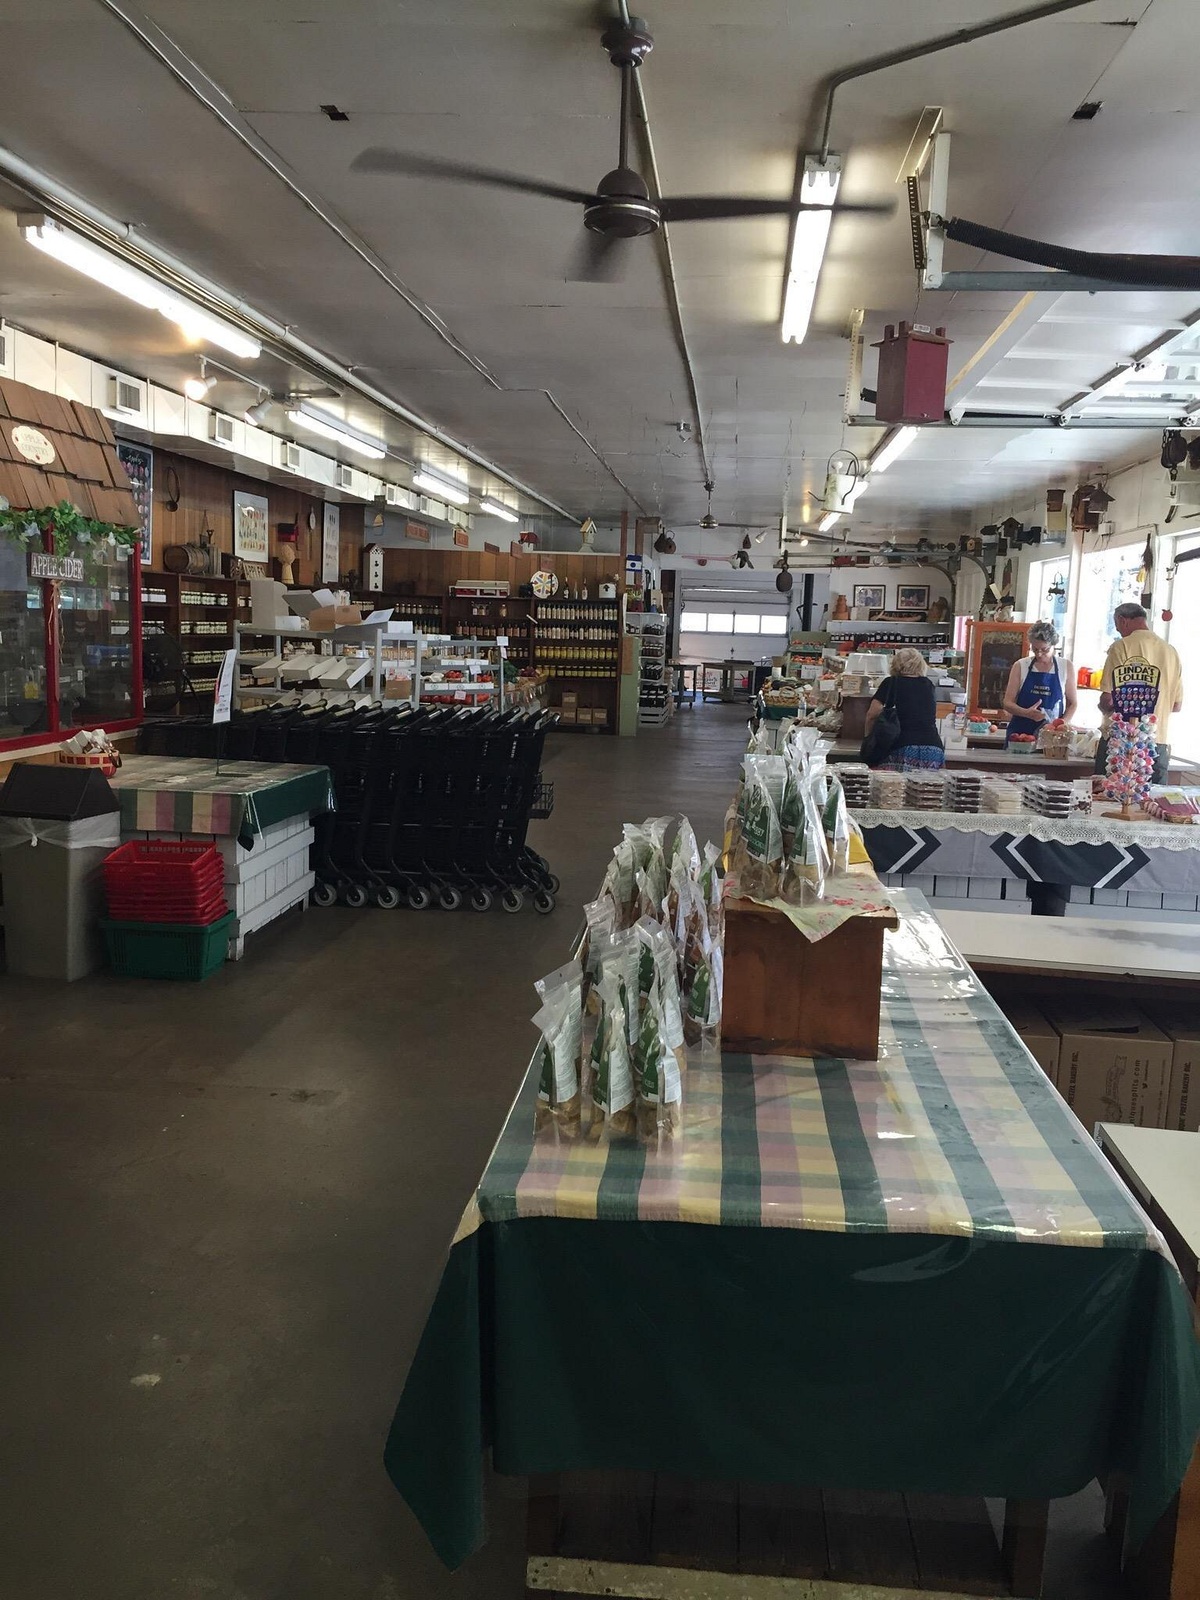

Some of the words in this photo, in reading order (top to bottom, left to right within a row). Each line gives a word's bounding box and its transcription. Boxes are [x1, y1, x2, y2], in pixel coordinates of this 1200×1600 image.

[31, 555, 58, 577] APPLE
[58, 557, 84, 580] CIDER
[1118, 665, 1155, 676] LINDA'S
[1118, 674, 1154, 684] LOLLIES
[1069, 1063, 1078, 1084] BAKERY
[1181, 1073, 1190, 1094] BAKERY
